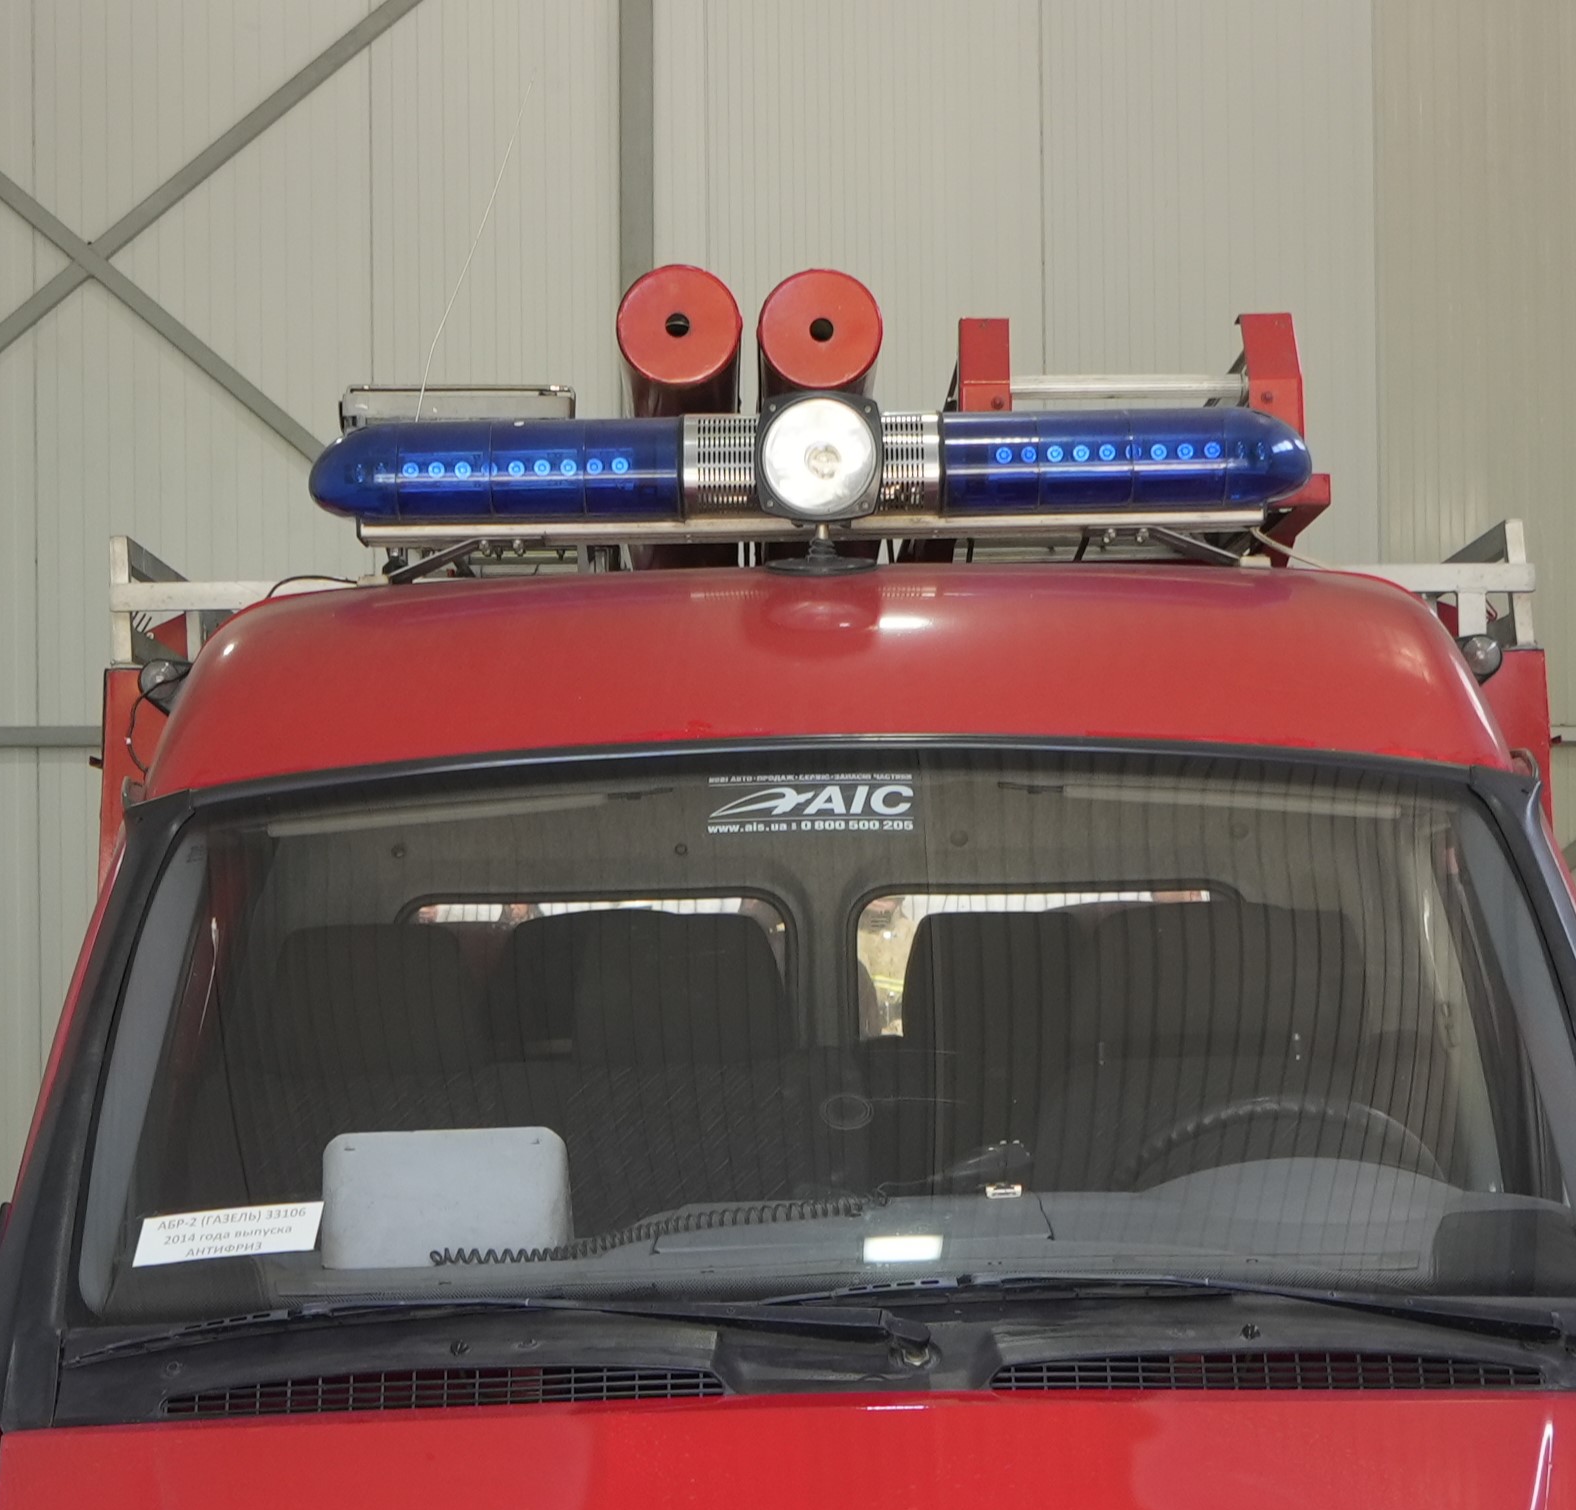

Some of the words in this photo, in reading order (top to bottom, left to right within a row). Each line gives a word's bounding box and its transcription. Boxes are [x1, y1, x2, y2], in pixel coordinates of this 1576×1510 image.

[707, 821, 788, 833] www.ais.ua
[814, 820, 846, 831] 800
[849, 820, 879, 831] 500
[882, 819, 914, 831] 205
[157, 1218, 197, 1231] АБР-2
[201, 1210, 263, 1228] (ГАЗЕЛЬ)
[265, 1207, 307, 1220] 33106
[163, 1233, 196, 1246] 2014
[199, 1230, 230, 1243] года
[234, 1225, 293, 1240] выпуска
[185, 1241, 263, 1258] АНТИФРИЗ
